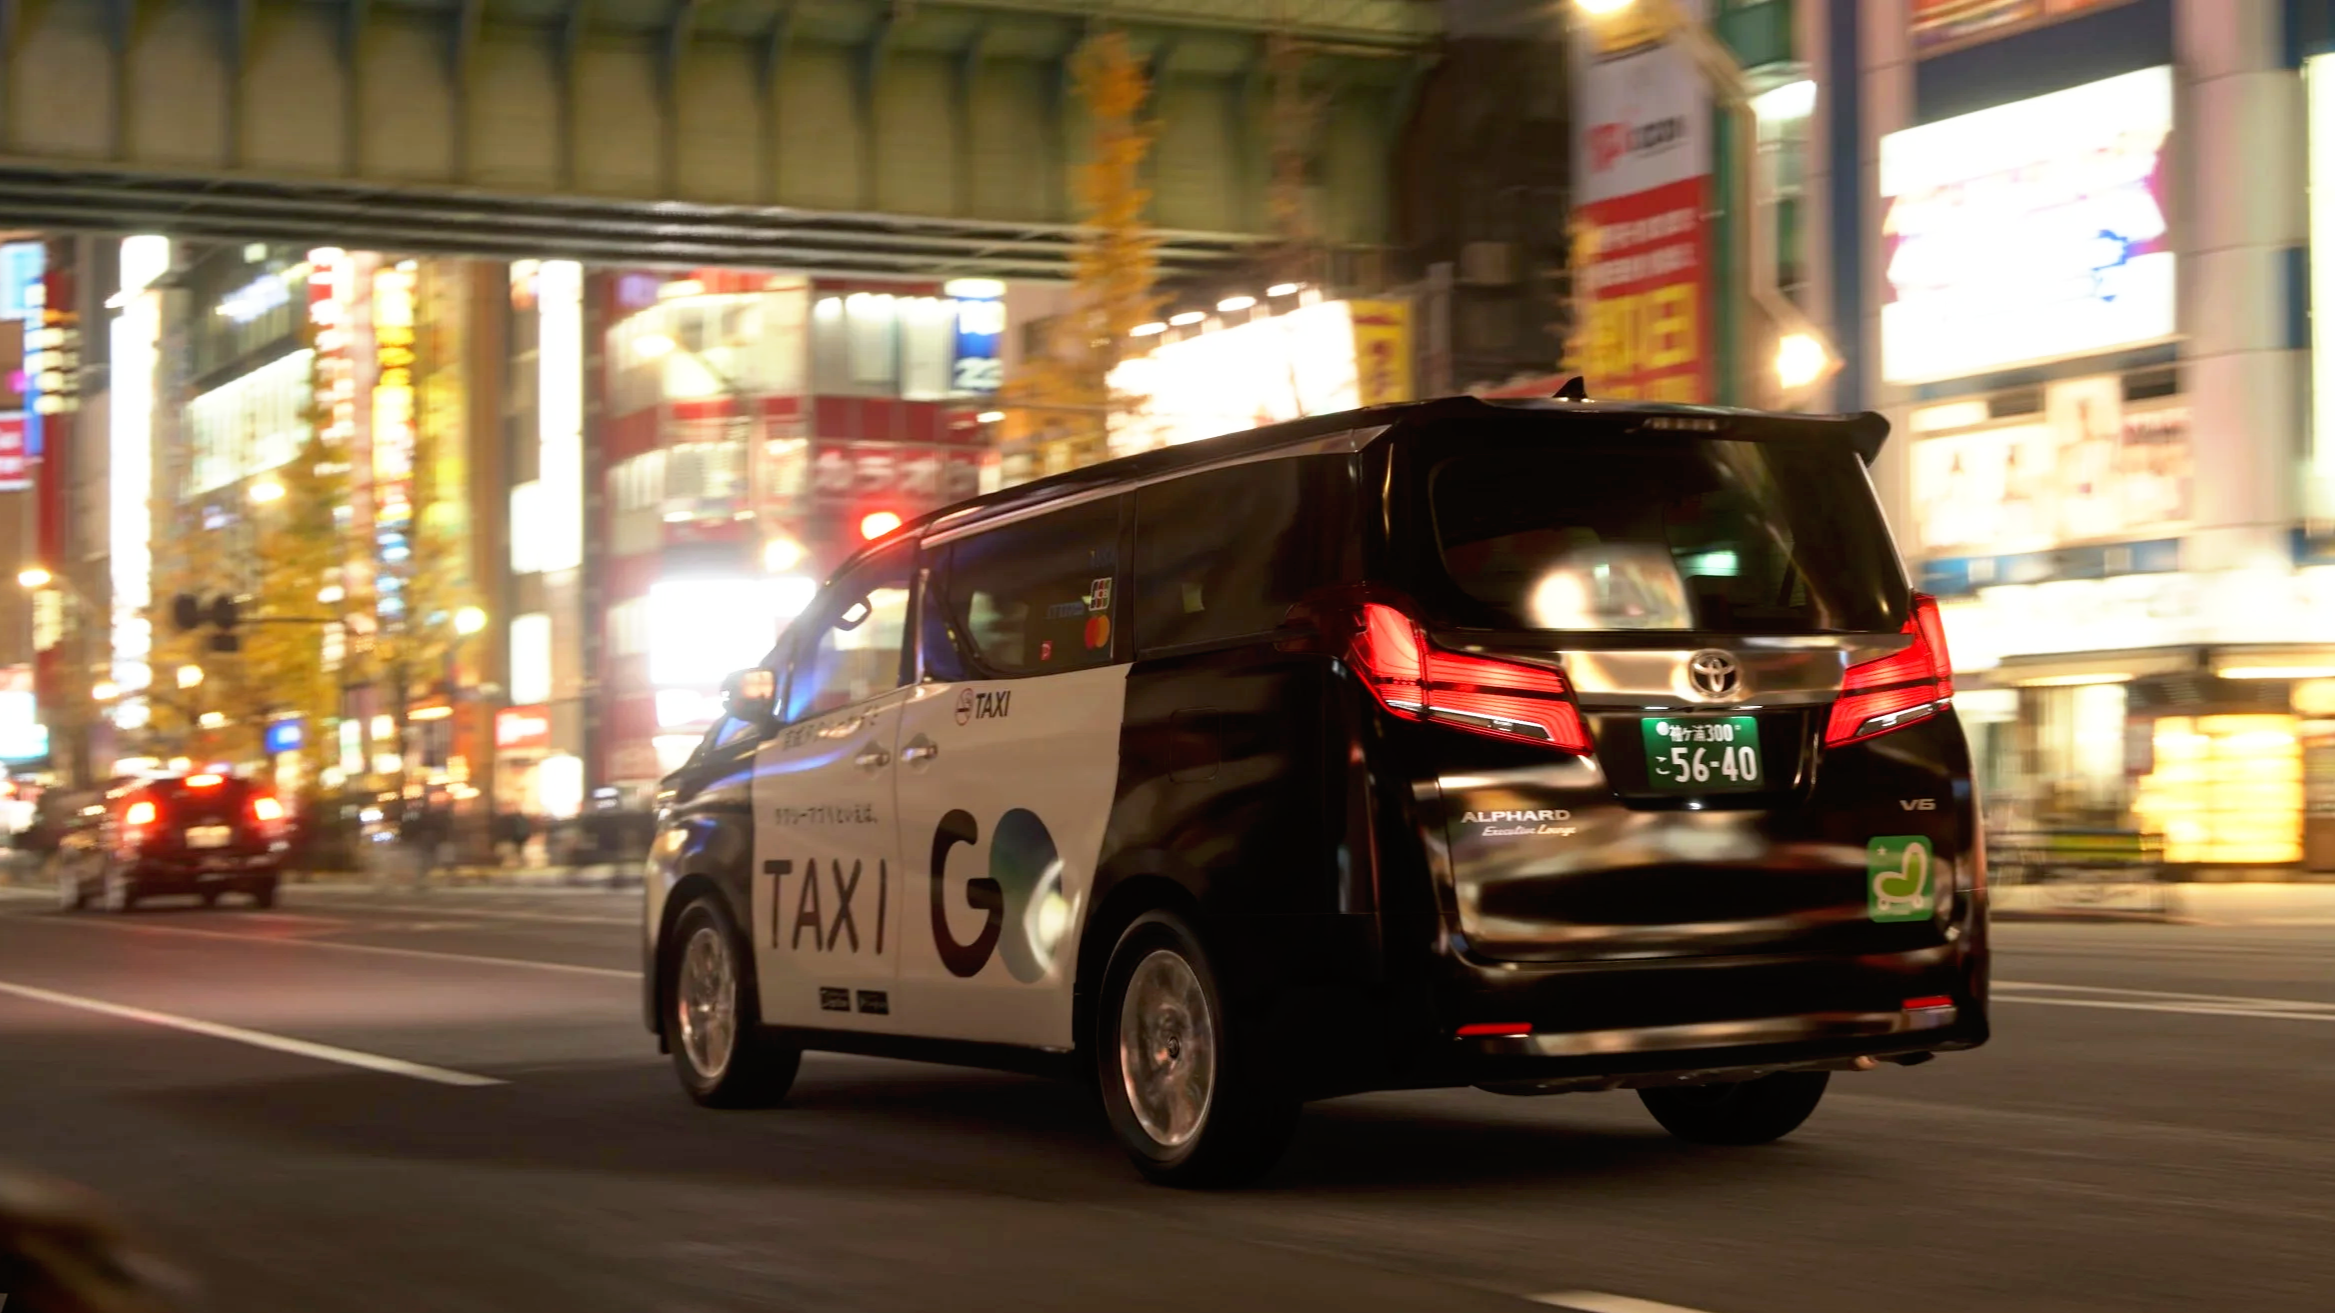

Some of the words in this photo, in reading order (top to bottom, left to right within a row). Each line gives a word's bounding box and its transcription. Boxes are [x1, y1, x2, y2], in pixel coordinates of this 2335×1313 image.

[976, 690, 1011, 719] TAXI
[1655, 756, 1671, 775] こ
[1671, 746, 1758, 783] 56-40
[1461, 809, 1571, 823] ALPHARD
[1899, 798, 1937, 811] V6
[764, 857, 886, 954] TAXI
[930, 807, 1063, 985] GO
